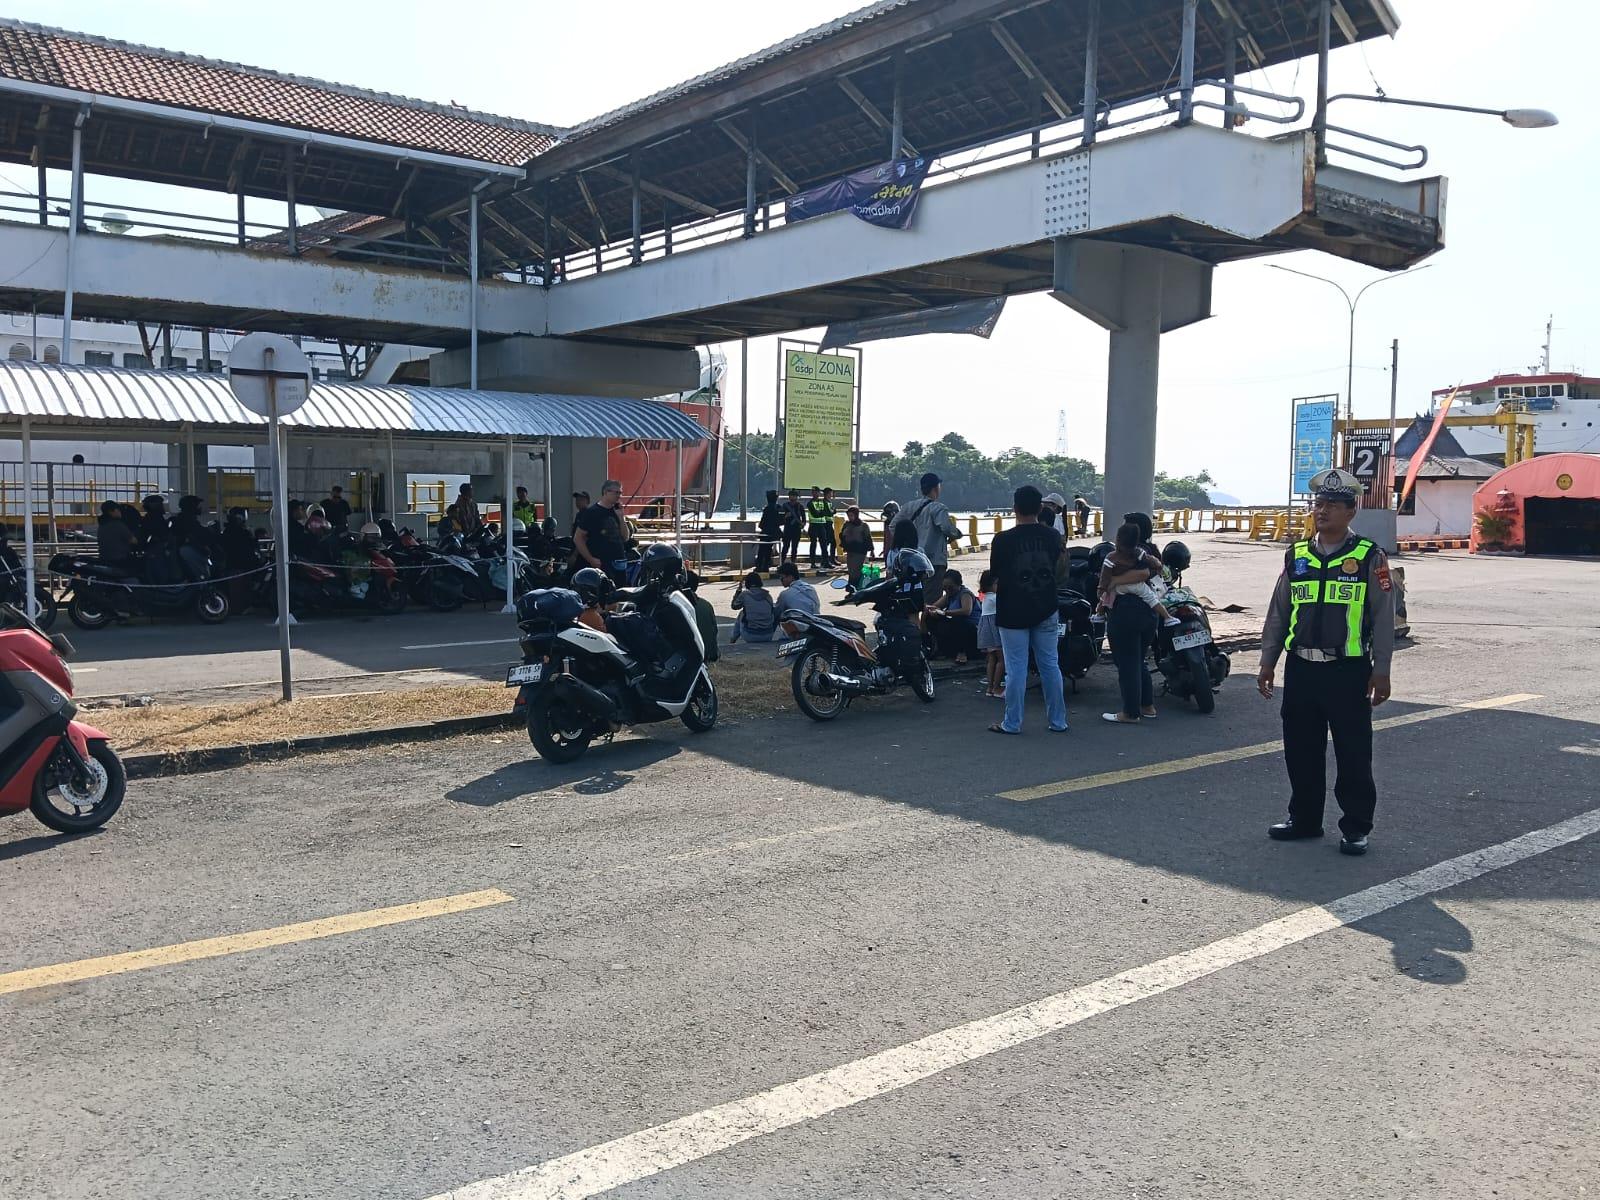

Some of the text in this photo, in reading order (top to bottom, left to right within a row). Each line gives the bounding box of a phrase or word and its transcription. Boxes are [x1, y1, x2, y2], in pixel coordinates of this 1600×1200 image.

[795, 365, 814, 375] asdp
[819, 361, 852, 376] ZONA
[808, 383, 826, 391] ZONA
[1312, 406, 1331, 417] ZONA
[1355, 449, 1375, 476] 2
